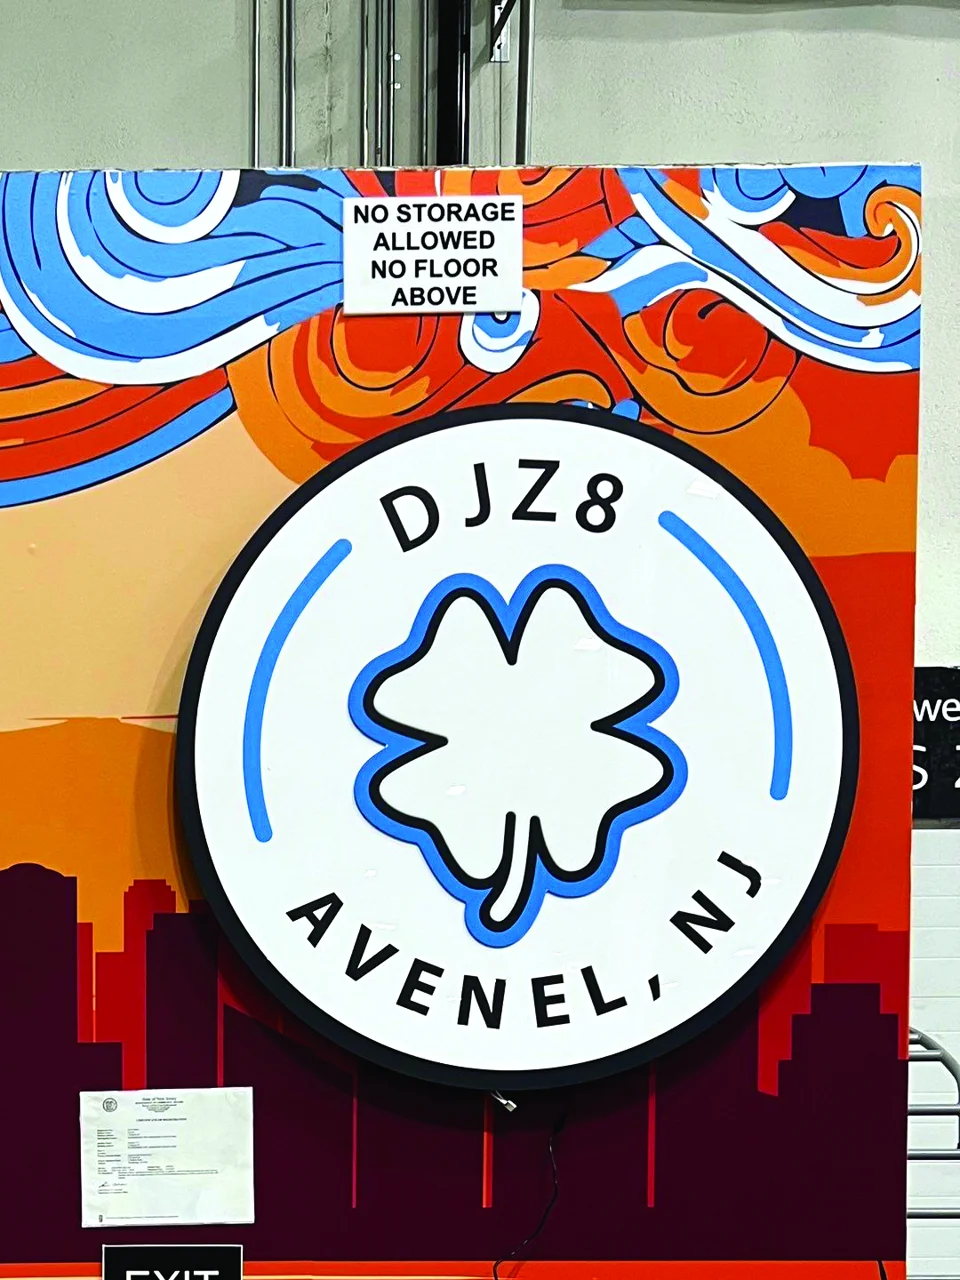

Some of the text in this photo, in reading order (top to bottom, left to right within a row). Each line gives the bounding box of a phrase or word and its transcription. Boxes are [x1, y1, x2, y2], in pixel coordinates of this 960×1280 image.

[353, 202, 516, 224] NO STORAGE
[373, 230, 496, 251] ALLOWED
[371, 258, 499, 279] NO FLOOR
[391, 286, 478, 306] ABOVE
[379, 458, 625, 553] DJZ8
[286, 850, 765, 1030] AVENEL, NJ
